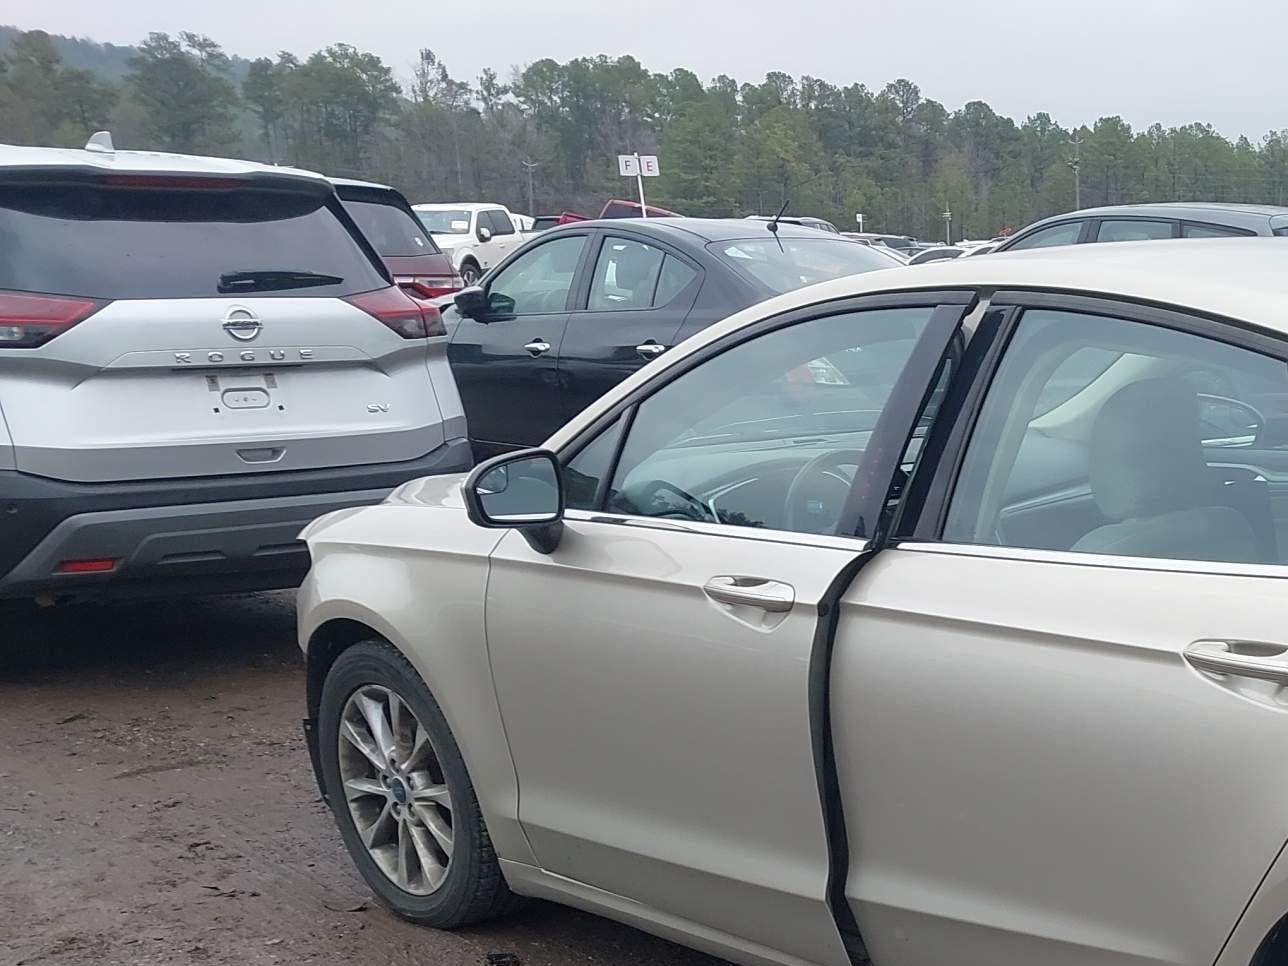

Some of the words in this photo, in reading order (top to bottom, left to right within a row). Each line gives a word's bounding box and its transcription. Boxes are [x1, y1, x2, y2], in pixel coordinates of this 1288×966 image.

[624, 160, 631, 171] F
[646, 161, 653, 172] E
[174, 349, 313, 364] ROGUE
[367, 403, 391, 414] SV
